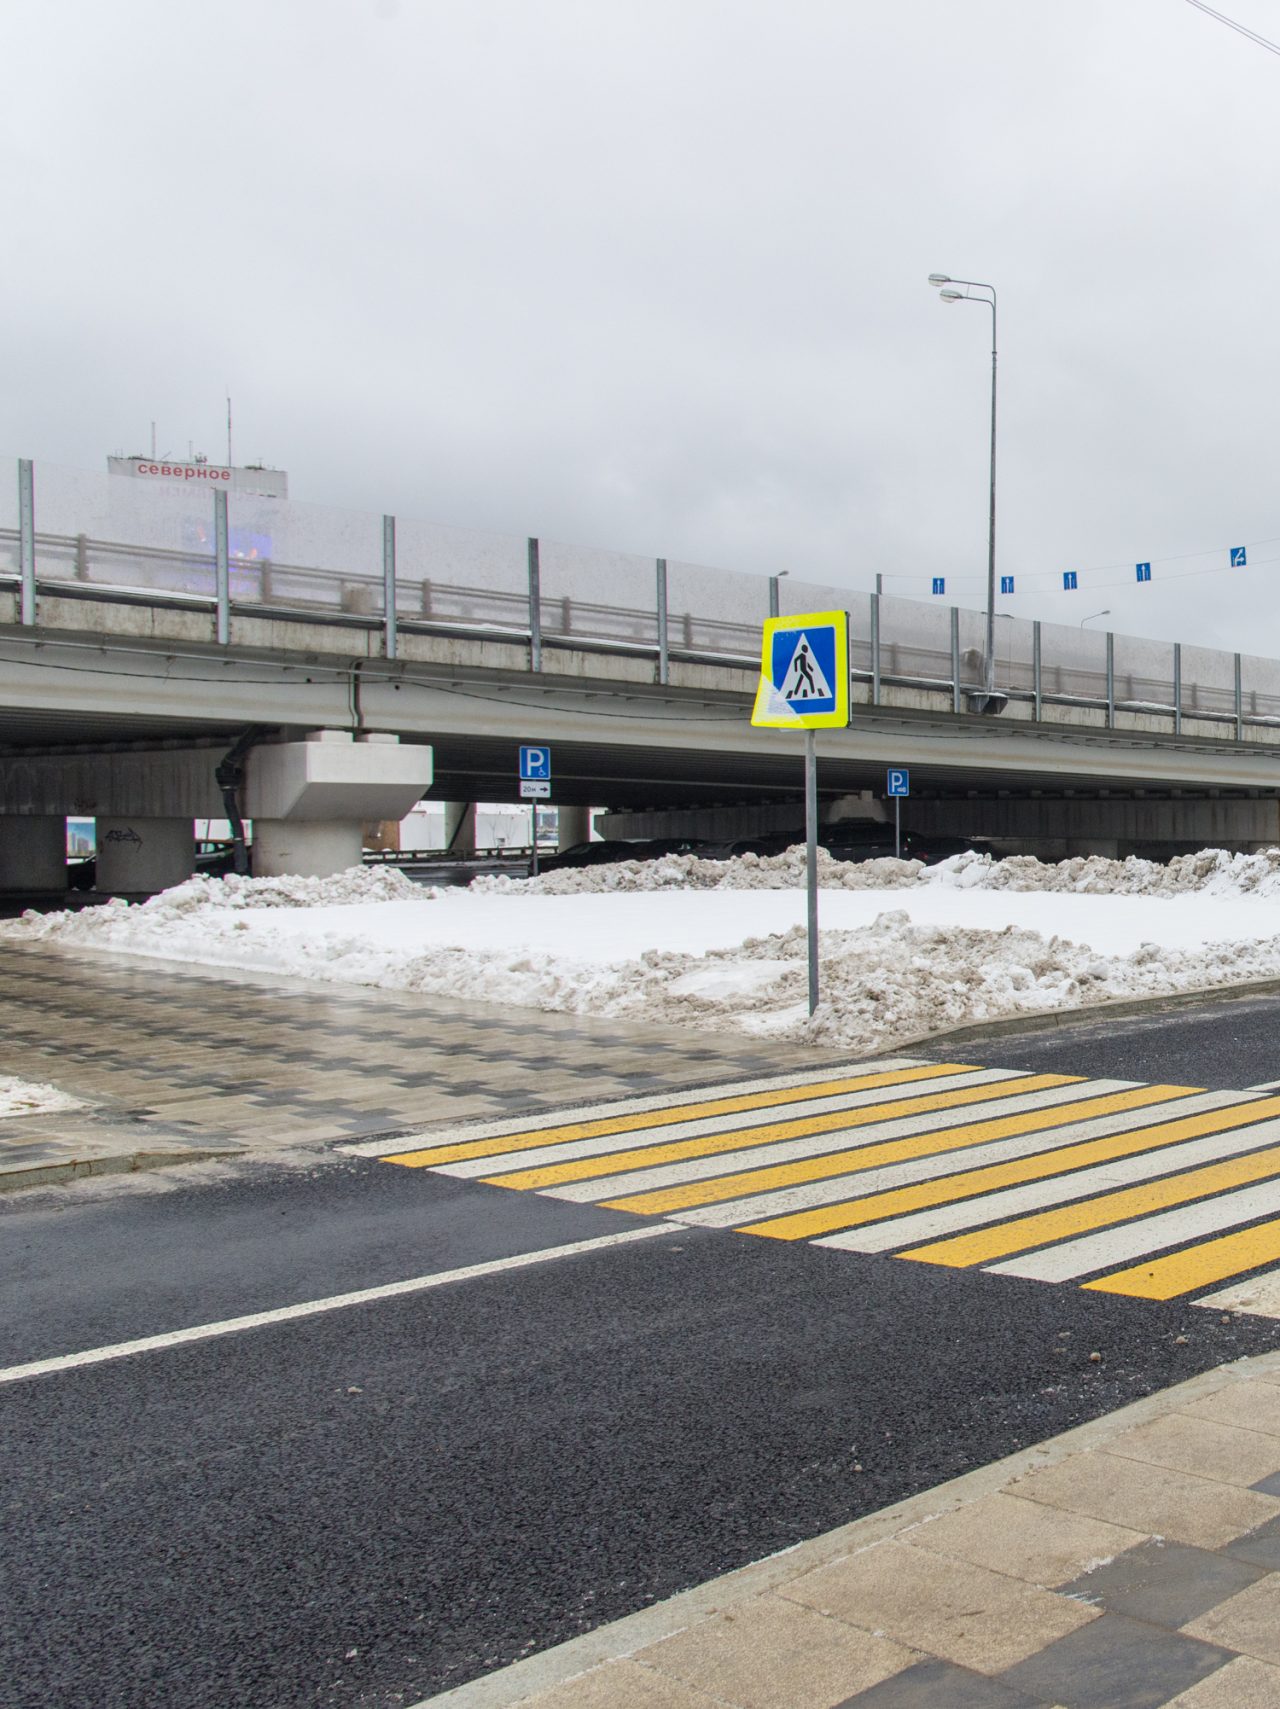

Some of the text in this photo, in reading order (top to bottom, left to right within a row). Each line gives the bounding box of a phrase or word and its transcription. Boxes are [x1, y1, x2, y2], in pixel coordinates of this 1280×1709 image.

[138, 464, 231, 480] северное
[527, 749, 544, 776] P
[892, 772, 903, 792] P
